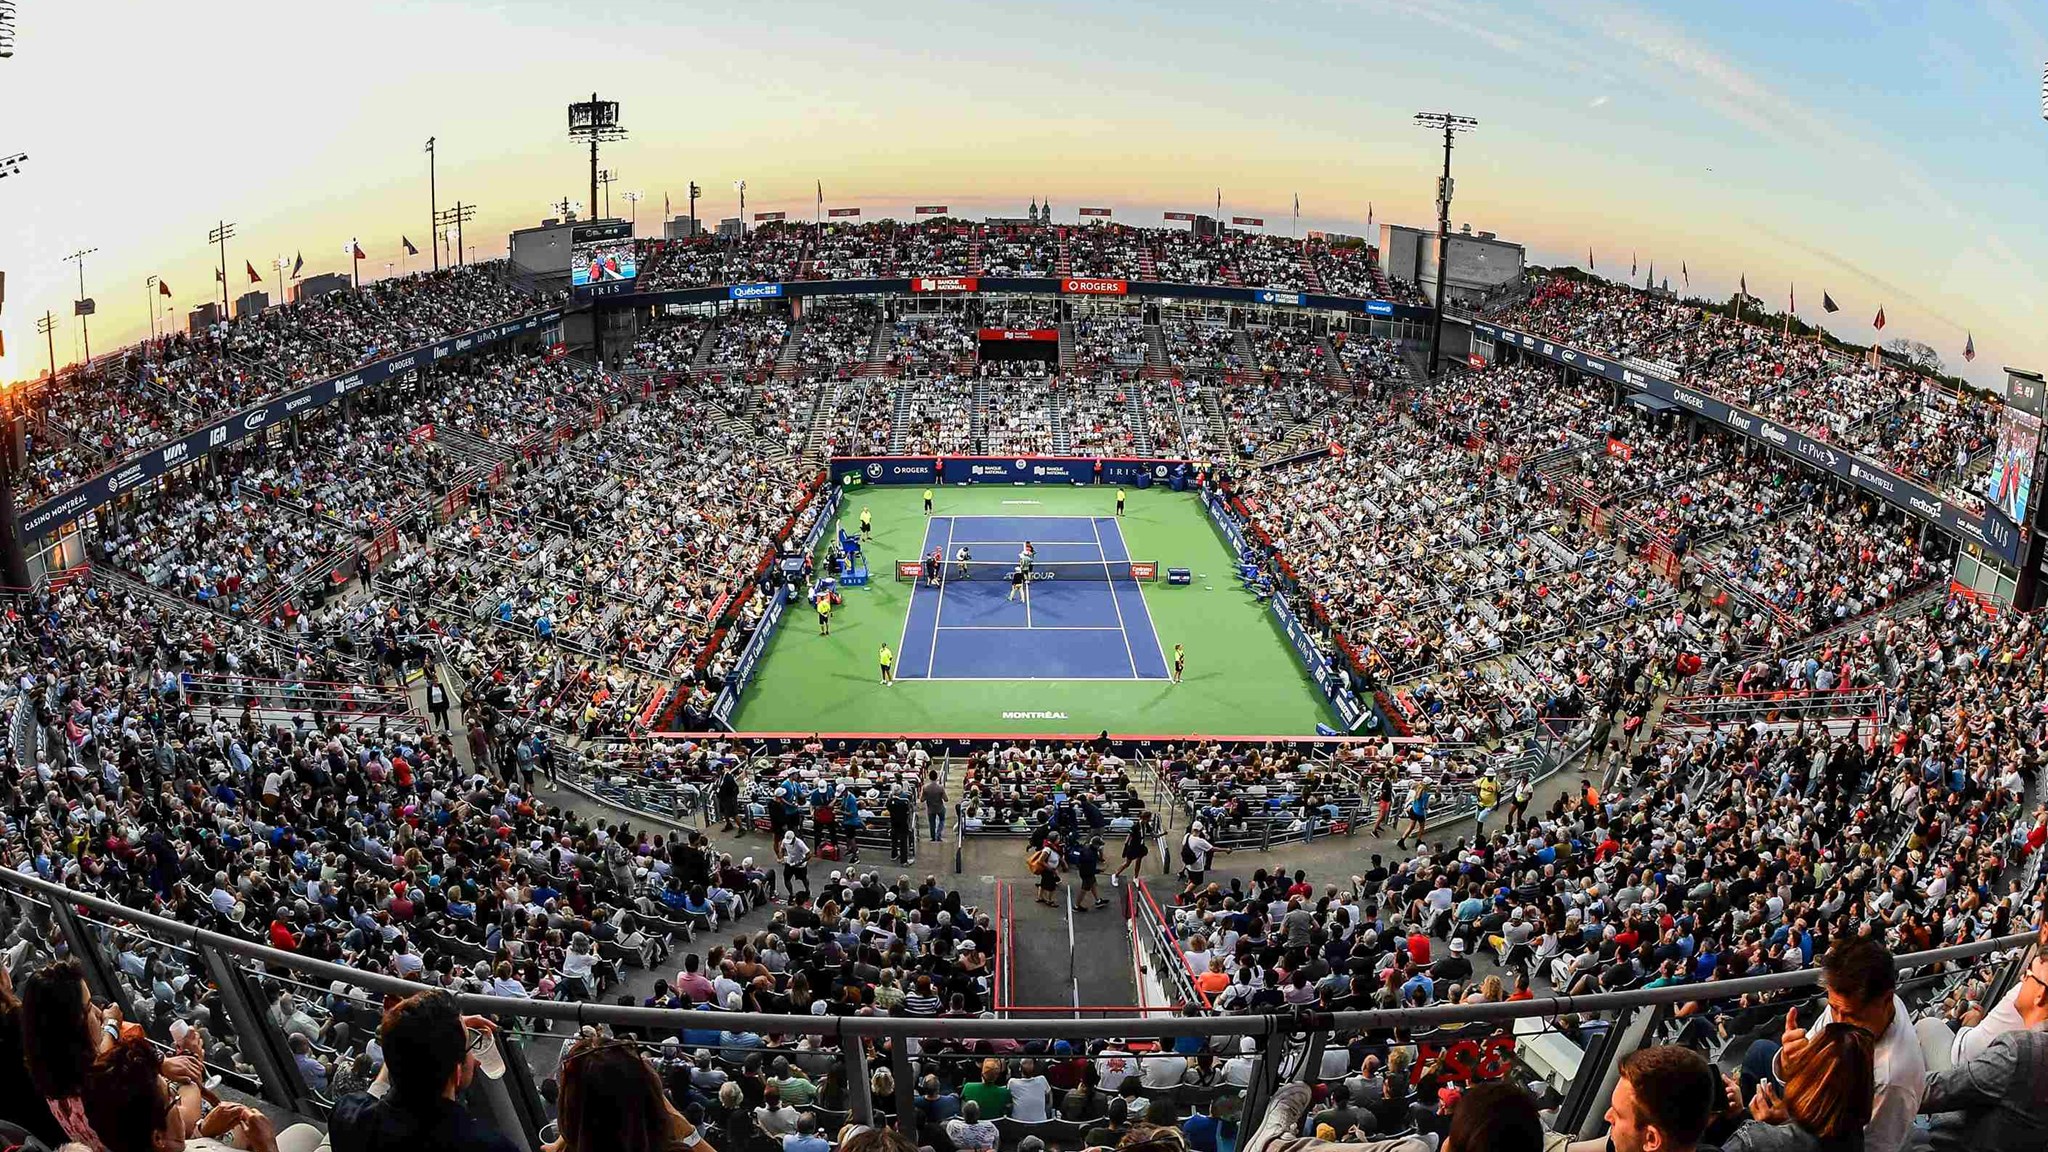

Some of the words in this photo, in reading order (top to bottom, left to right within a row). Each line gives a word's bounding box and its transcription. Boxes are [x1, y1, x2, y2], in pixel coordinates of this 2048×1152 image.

[590, 284, 620, 296] IRIS
[734, 287, 765, 297] Québec
[1080, 282, 1119, 291] ROGERS
[394, 356, 415, 370] ROGERS
[285, 395, 311, 411] NESPRESSO
[1680, 392, 1704, 409] ROGERS
[1727, 409, 1751, 431] flow
[209, 425, 227, 447] IGA
[163, 443, 182, 462] VIA
[1109, 467, 1137, 476] IRIS
[1858, 469, 1894, 493] CROMWELL
[24, 512, 51, 531] CASINO
[51, 494, 87, 517] MONTRÉAL
[1990, 518, 2009, 548] IRIS
[1002, 711, 1068, 719] MONTRÉAL
